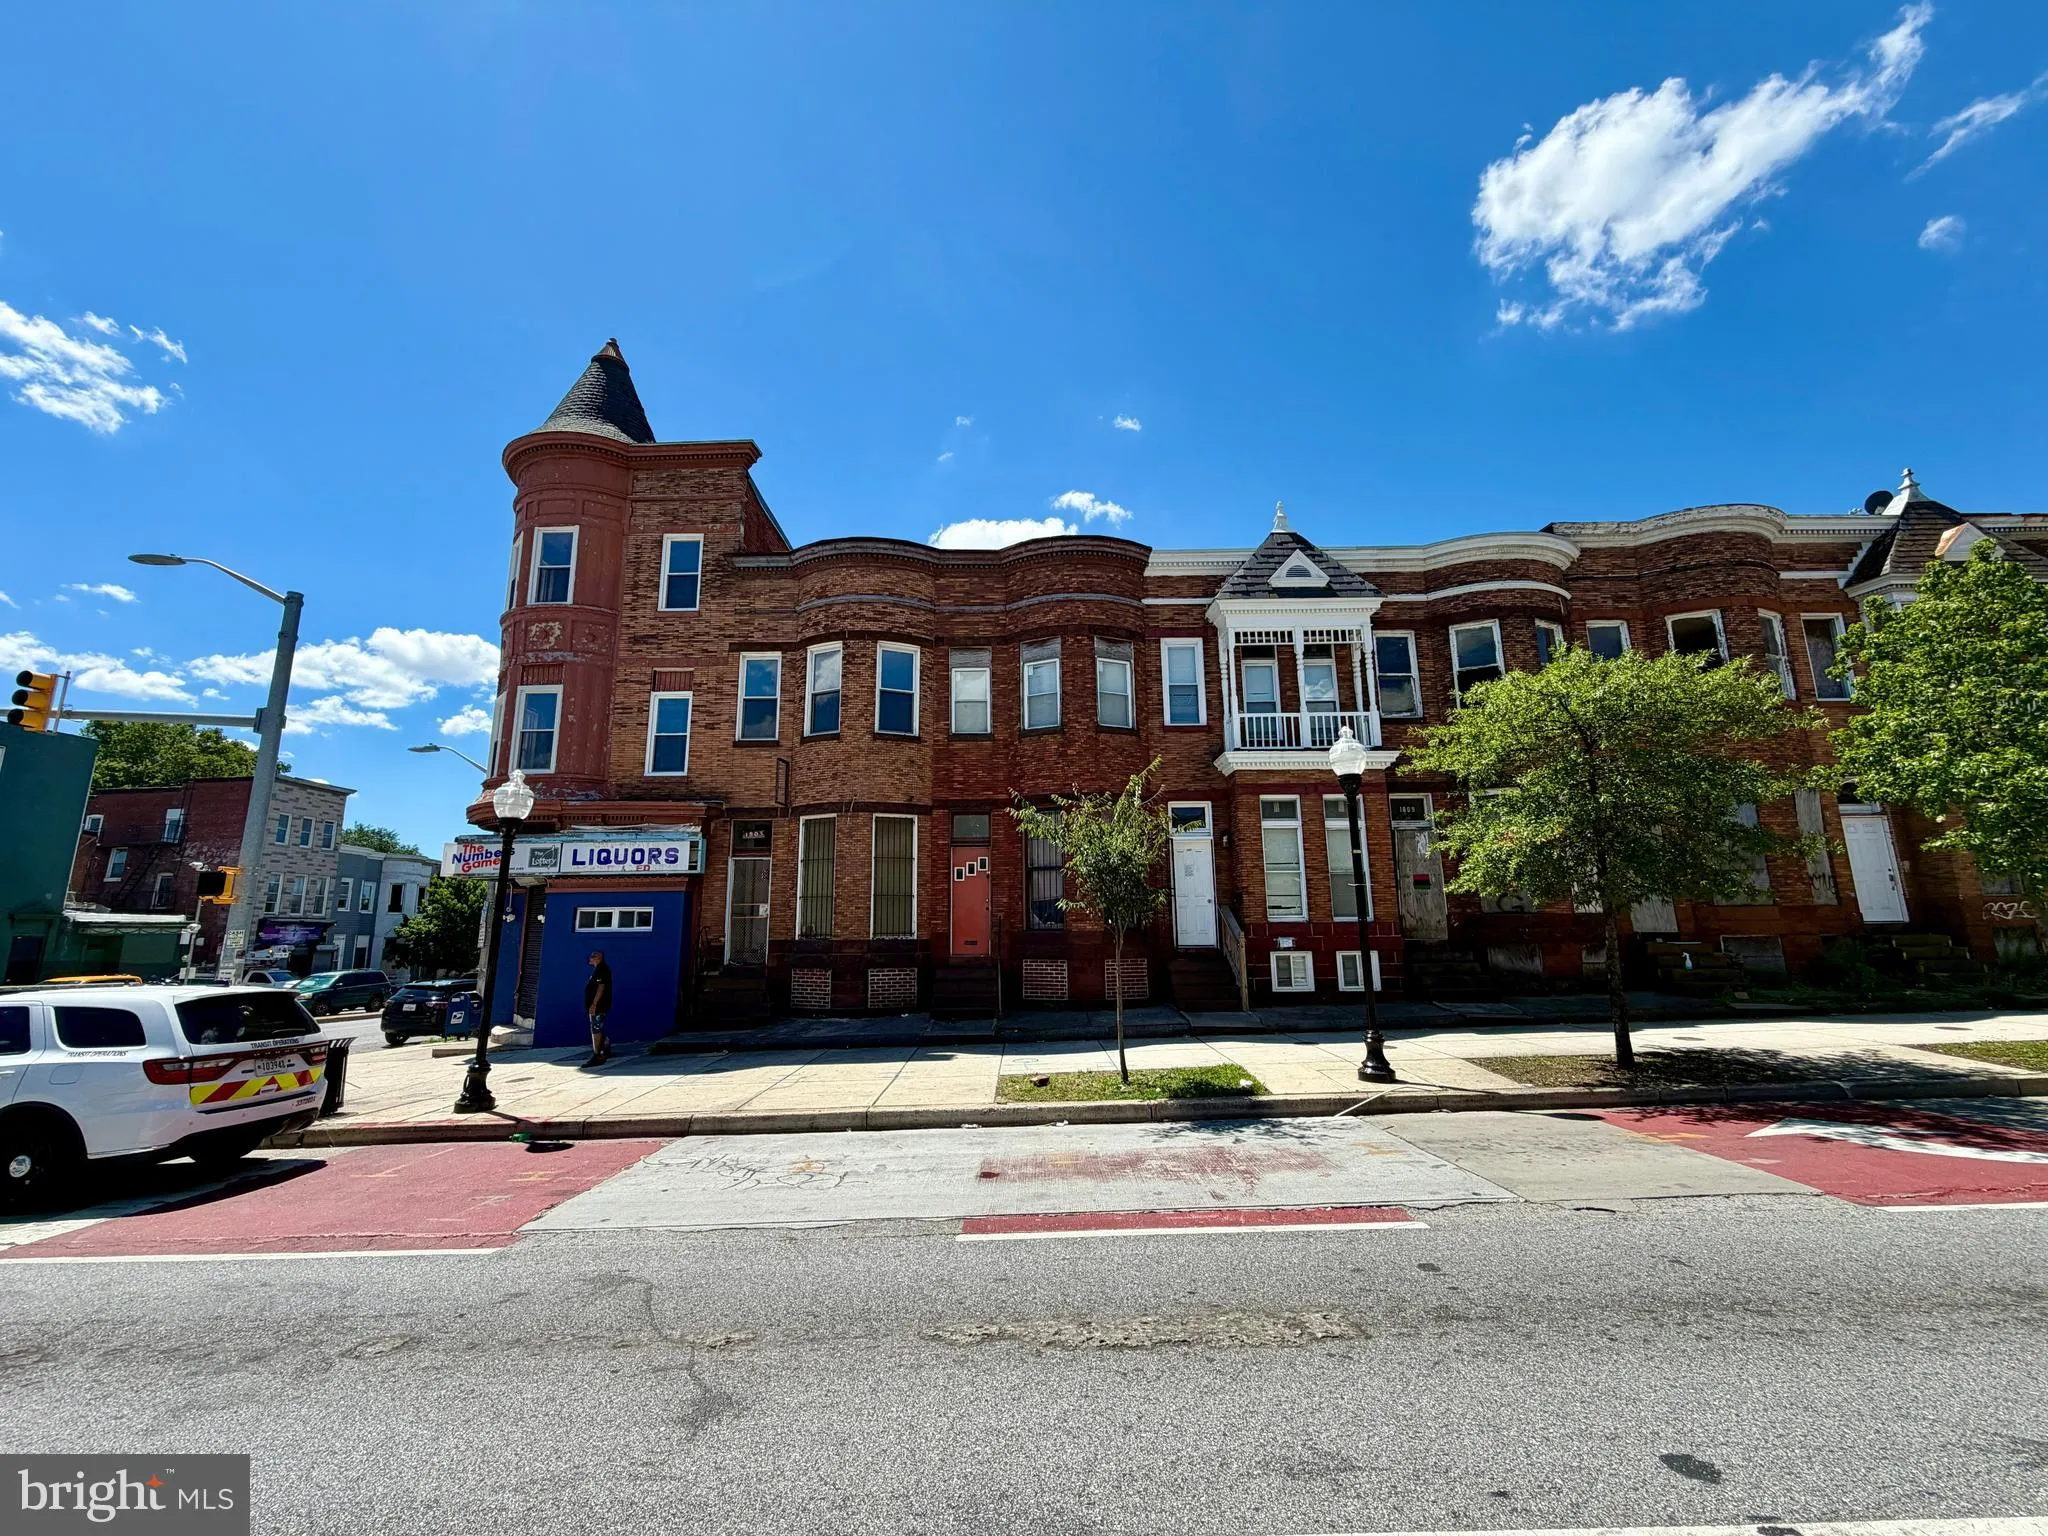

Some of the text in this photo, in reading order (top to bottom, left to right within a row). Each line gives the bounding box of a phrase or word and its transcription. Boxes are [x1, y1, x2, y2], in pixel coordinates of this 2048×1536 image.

[462, 843, 485, 855] The
[452, 848, 515, 864] Numbes
[531, 857, 556, 868] Lottery
[571, 847, 680, 866] LIQUORS
[461, 858, 501, 873] Game
[250, 1038, 300, 1049] TRANSIT OPERATIONS
